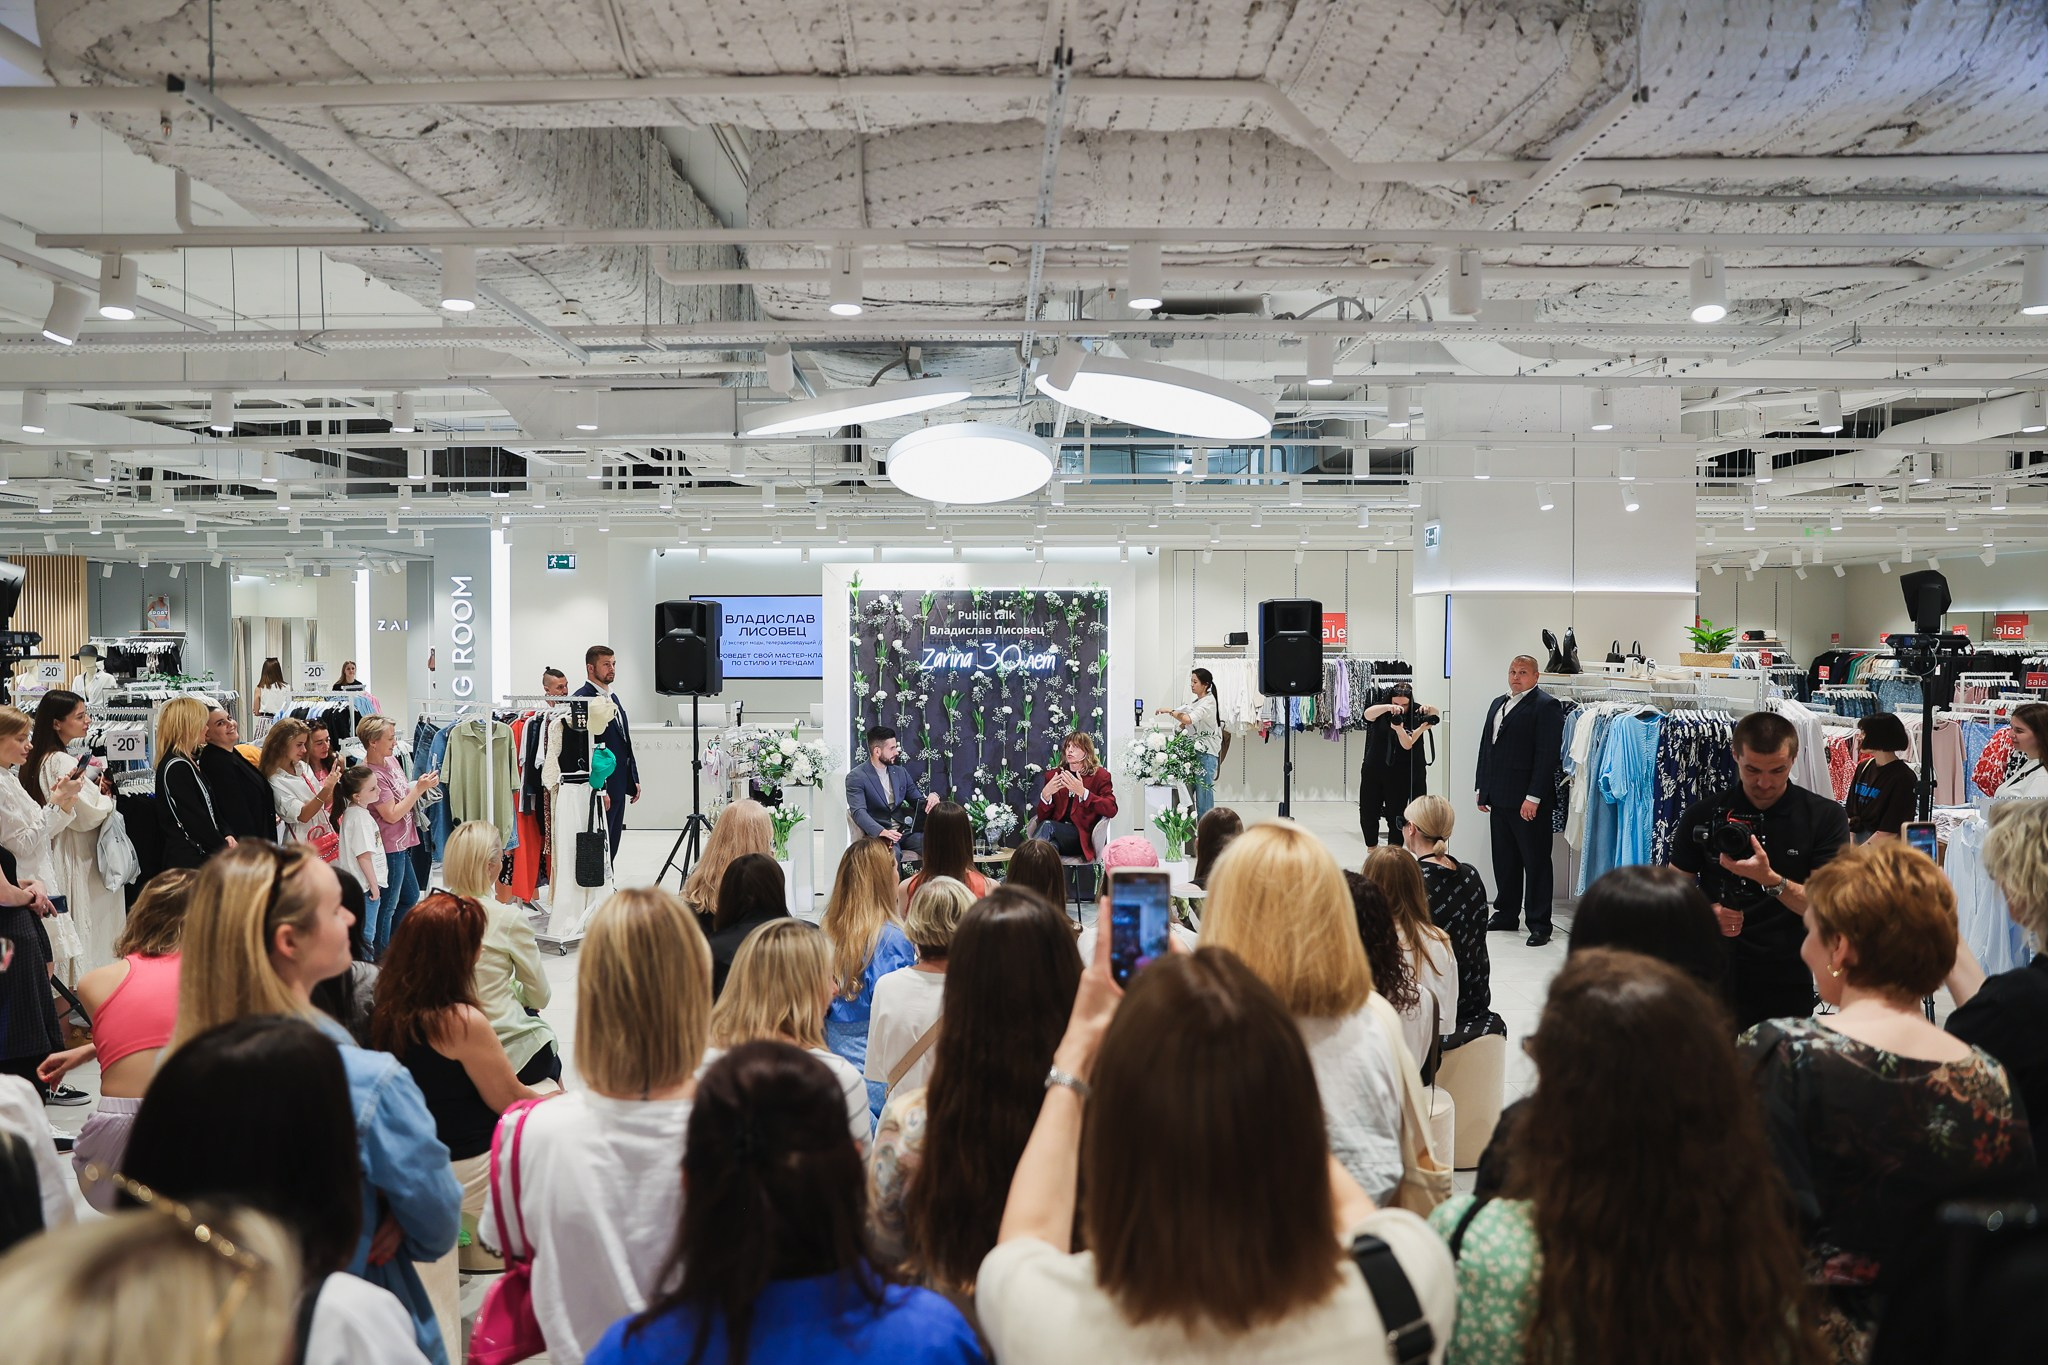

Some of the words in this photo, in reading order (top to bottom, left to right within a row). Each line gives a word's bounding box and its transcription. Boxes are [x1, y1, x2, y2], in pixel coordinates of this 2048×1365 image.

[451, 576, 473, 664] ROOM
[725, 614, 816, 625] ВЛАДИСЛАВ
[958, 610, 991, 620] Public
[994, 610, 1016, 620] talk
[738, 626, 807, 637] ЛИСОВЕЦ
[929, 626, 992, 636] Владислав
[994, 626, 1045, 636] Лисовец
[1322, 625, 1346, 639] ale
[920, 648, 974, 670] Zarina
[976, 642, 1022, 670] 30
[2027, 678, 2047, 686] sale
